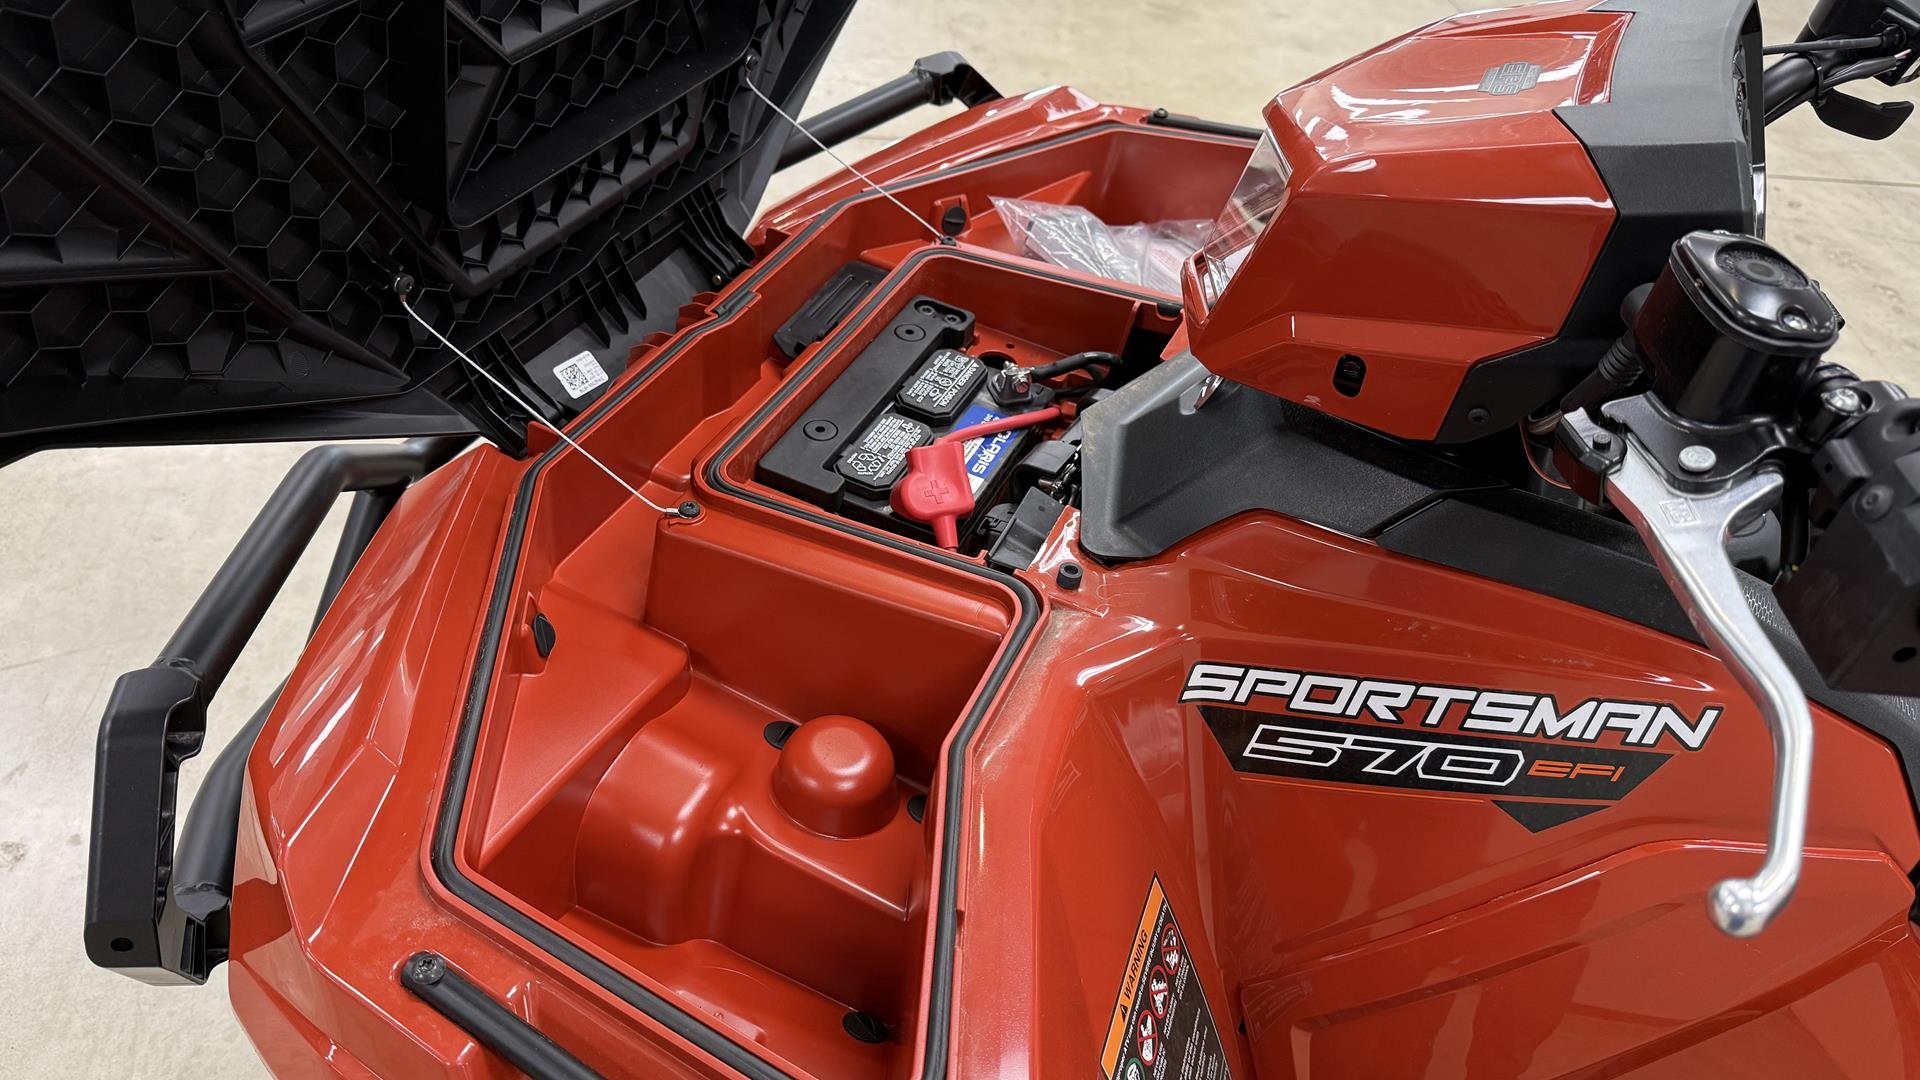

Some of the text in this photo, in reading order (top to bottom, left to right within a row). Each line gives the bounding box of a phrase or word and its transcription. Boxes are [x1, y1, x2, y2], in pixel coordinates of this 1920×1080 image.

[939, 388, 958, 406] POISON
[956, 367, 976, 386] DANGER
[1182, 665, 1719, 748] SPORTSMAN
[1242, 723, 1624, 787] 570 EFI
[1124, 929, 1149, 1000] WARNING
